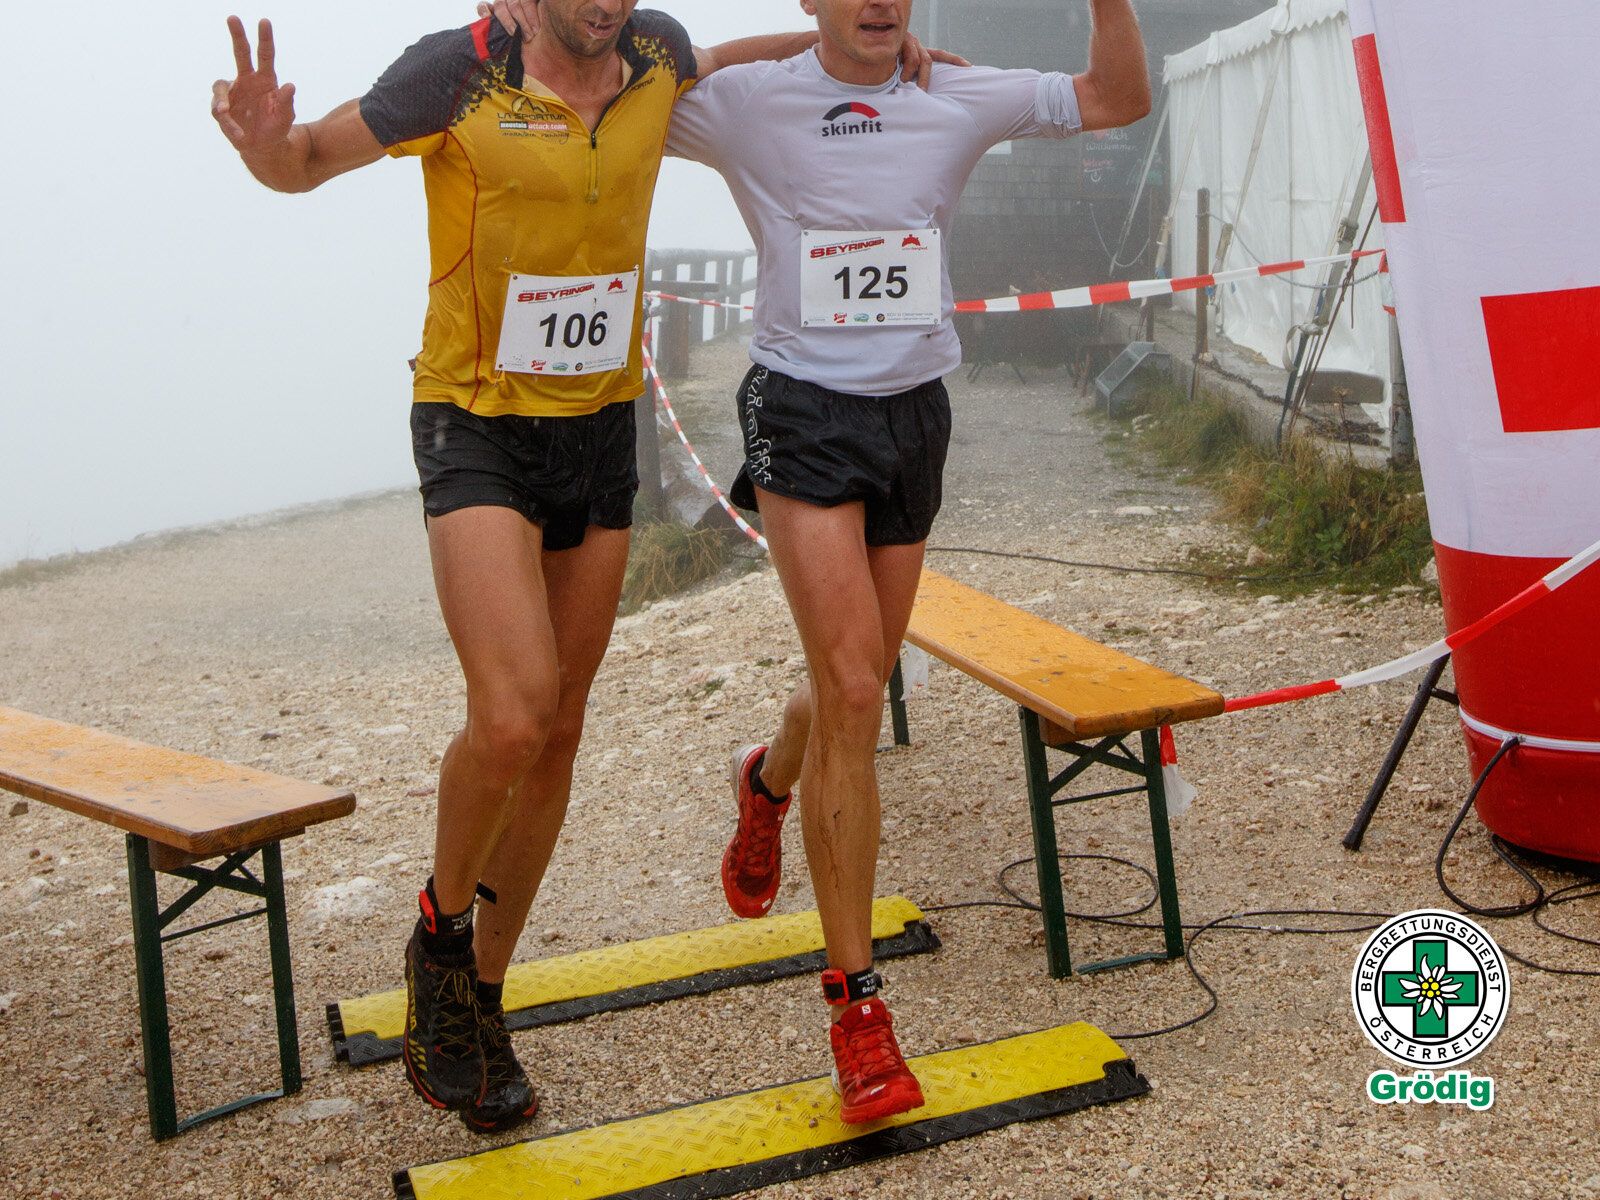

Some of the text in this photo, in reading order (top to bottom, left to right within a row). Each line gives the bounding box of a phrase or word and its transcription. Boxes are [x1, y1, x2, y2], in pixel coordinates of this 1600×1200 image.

[497, 112, 511, 120] LA
[821, 120, 883, 137] skinfit
[810, 238, 885, 259] SEYRINGER
[834, 265, 909, 300] 125
[517, 283, 596, 303] SEYRINGER
[539, 310, 608, 349] 106
